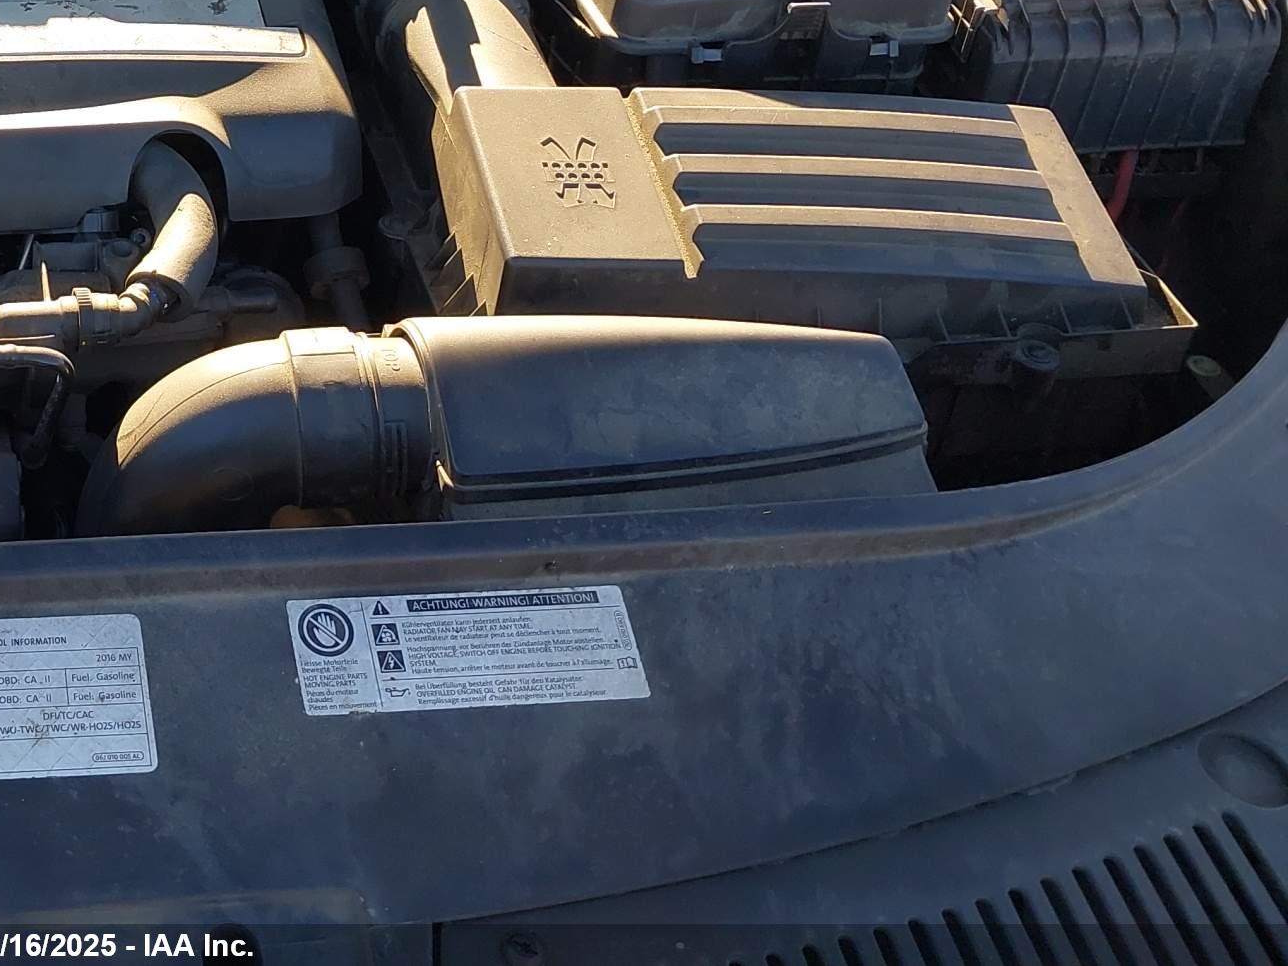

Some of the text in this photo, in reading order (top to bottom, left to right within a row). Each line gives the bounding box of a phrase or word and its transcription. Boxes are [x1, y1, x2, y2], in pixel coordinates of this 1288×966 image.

[413, 593, 594, 610] ACHTUNG! WARNING! ATTENTION!
[11, 636, 67, 647] INFORMATION
[96, 653, 132, 662] 2016 MY
[96, 672, 135, 681] Gasoline
[26, 695, 38, 703] CA
[99, 691, 136, 700] Gasoline
